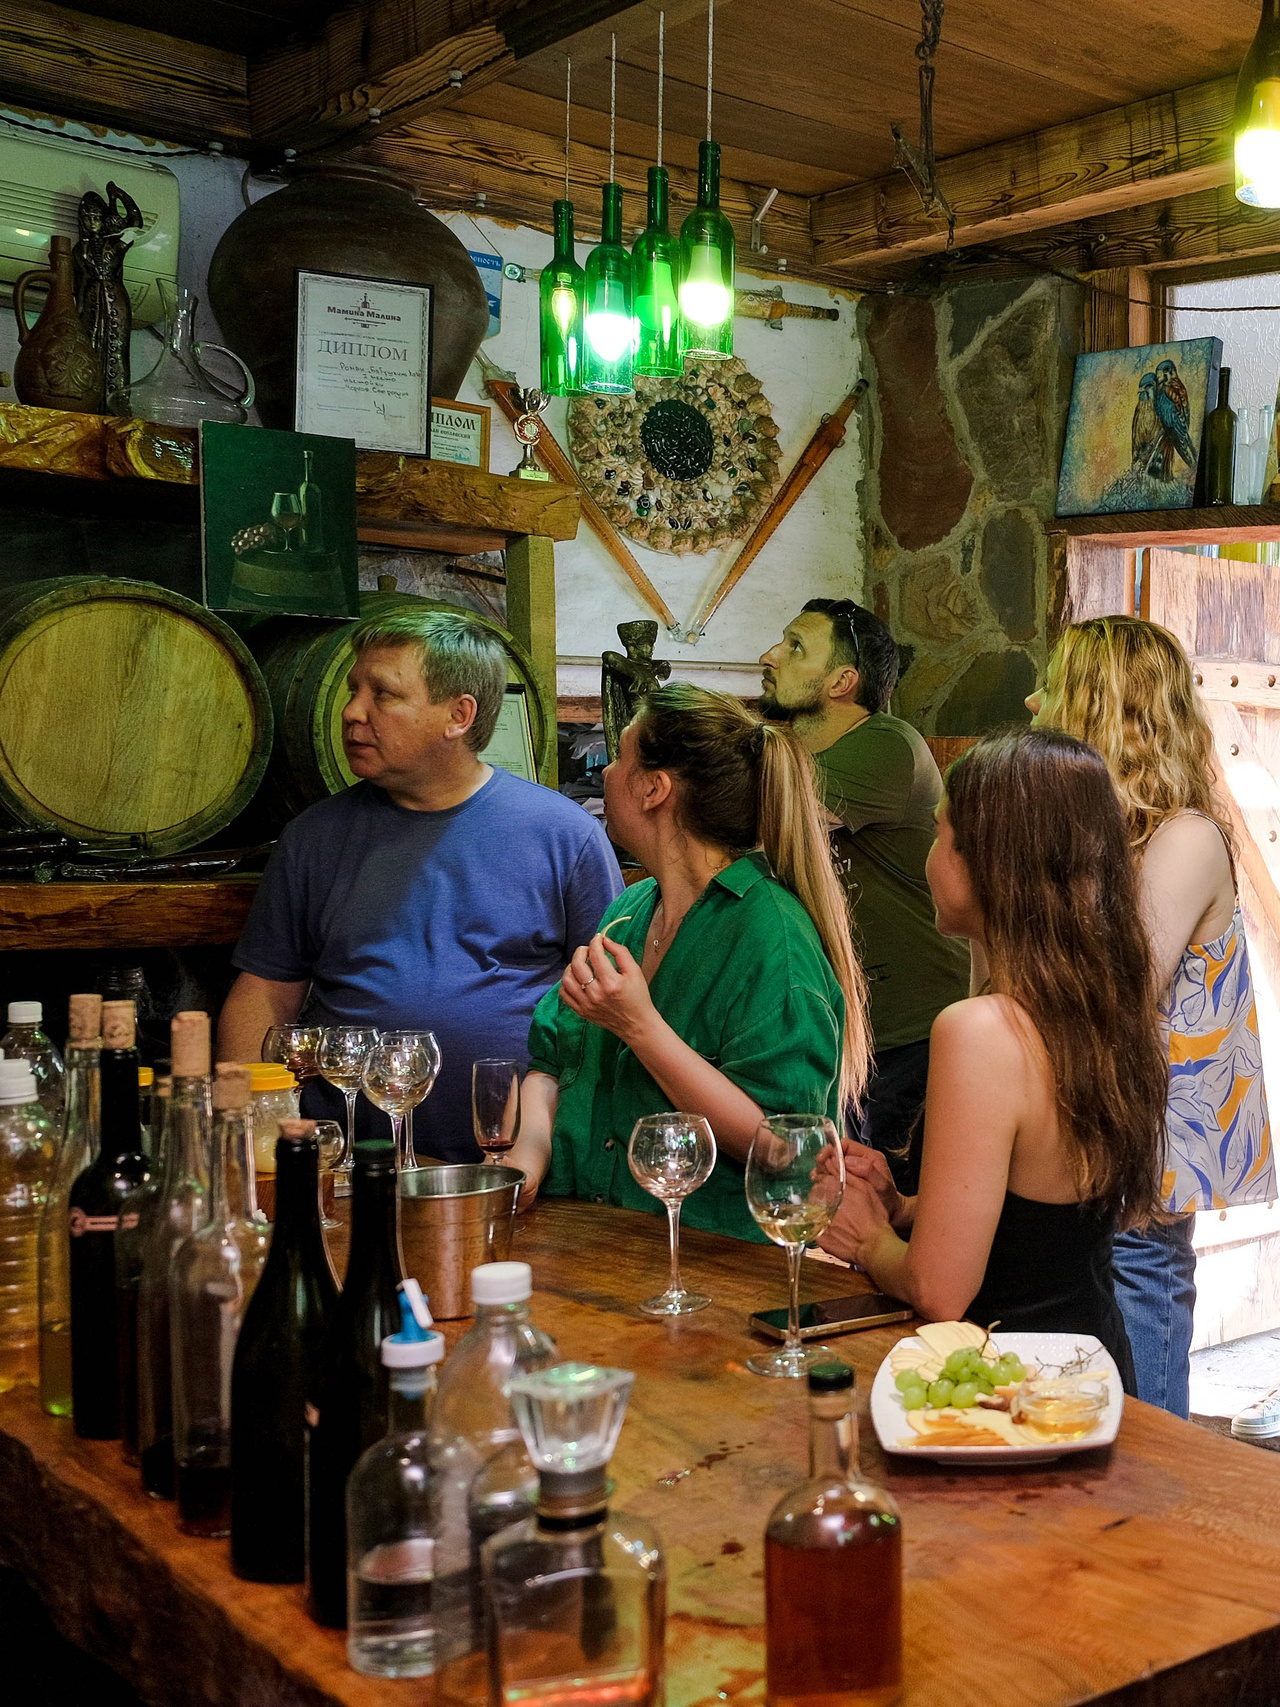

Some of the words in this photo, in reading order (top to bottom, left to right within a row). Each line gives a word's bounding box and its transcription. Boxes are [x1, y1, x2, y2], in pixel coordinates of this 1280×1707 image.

[327, 306, 364, 317] Мамина
[367, 310, 401, 322] Малина
[318, 339, 407, 361] ДИПЛОМ
